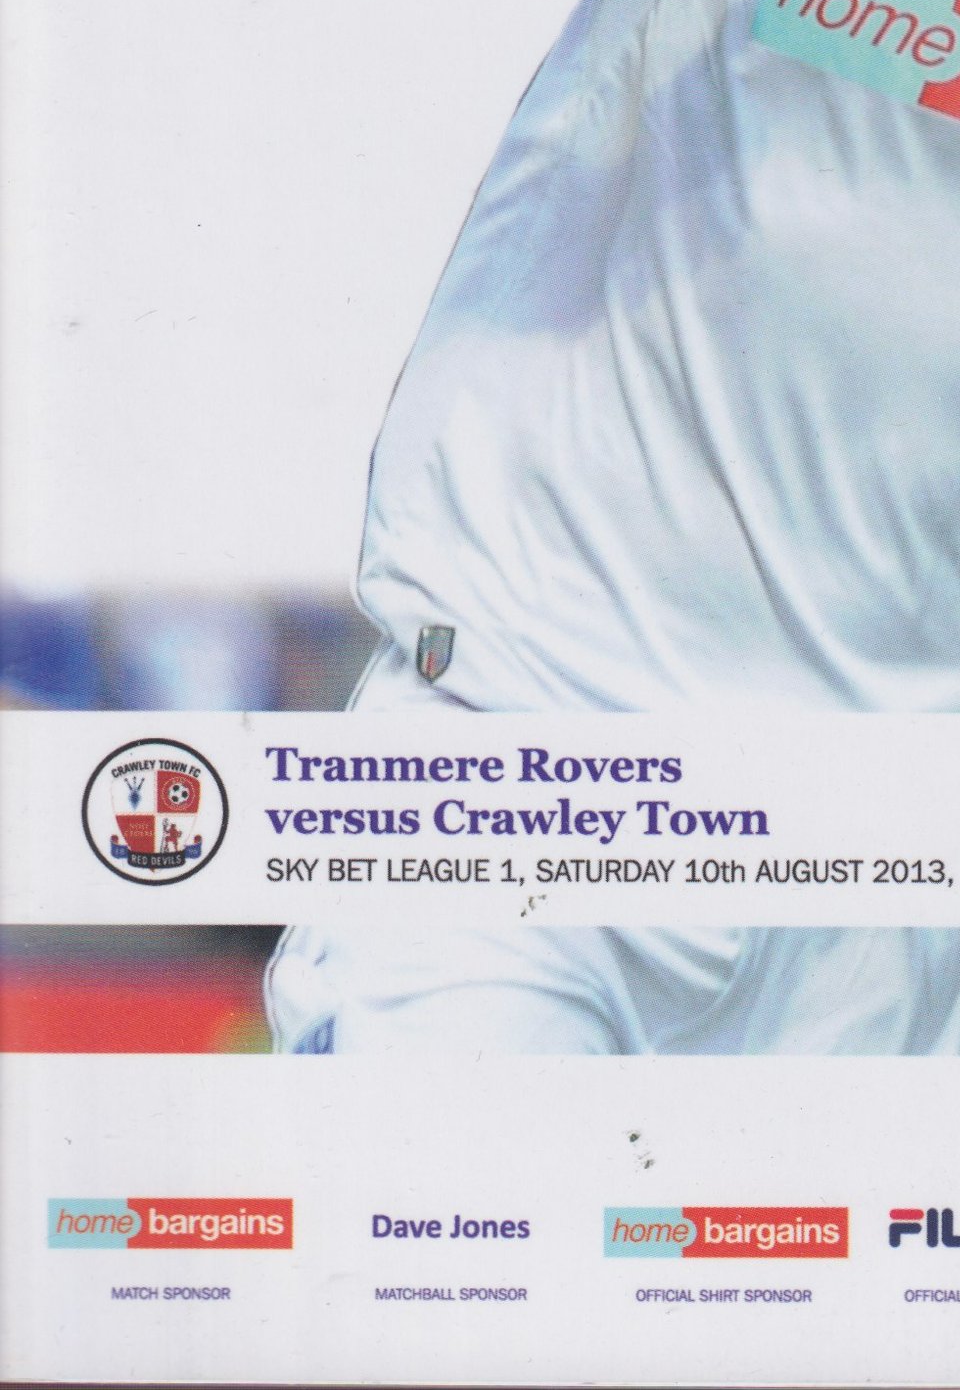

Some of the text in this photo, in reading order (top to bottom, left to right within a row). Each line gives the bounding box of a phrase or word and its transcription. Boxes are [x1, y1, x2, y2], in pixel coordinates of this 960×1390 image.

[111, 760, 201, 779] CRAWLEY TOWN FC
[266, 748, 682, 783] Tranmere Rovers
[265, 798, 769, 840] versus Crawley Town
[131, 854, 182, 865] RED DEVILS
[267, 858, 318, 882] SKY
[329, 859, 377, 881] BET
[388, 859, 490, 882] LEAGUE
[501, 859, 524, 886] 1,
[537, 859, 675, 883] SATURDAY
[686, 859, 745, 883] 10th
[756, 859, 863, 883] AUGUST
[873, 860, 953, 887] 2013,
[56, 1208, 284, 1241] home bargains
[373, 1215, 530, 1238] Dave Jones
[612, 1217, 840, 1250] home bargains
[112, 1287, 230, 1300] MATCH SPONSOR
[376, 1288, 527, 1301] MATCHBALL SPONSOR
[636, 1289, 812, 1303] OFFICIAL SHIRT SPONSOR
